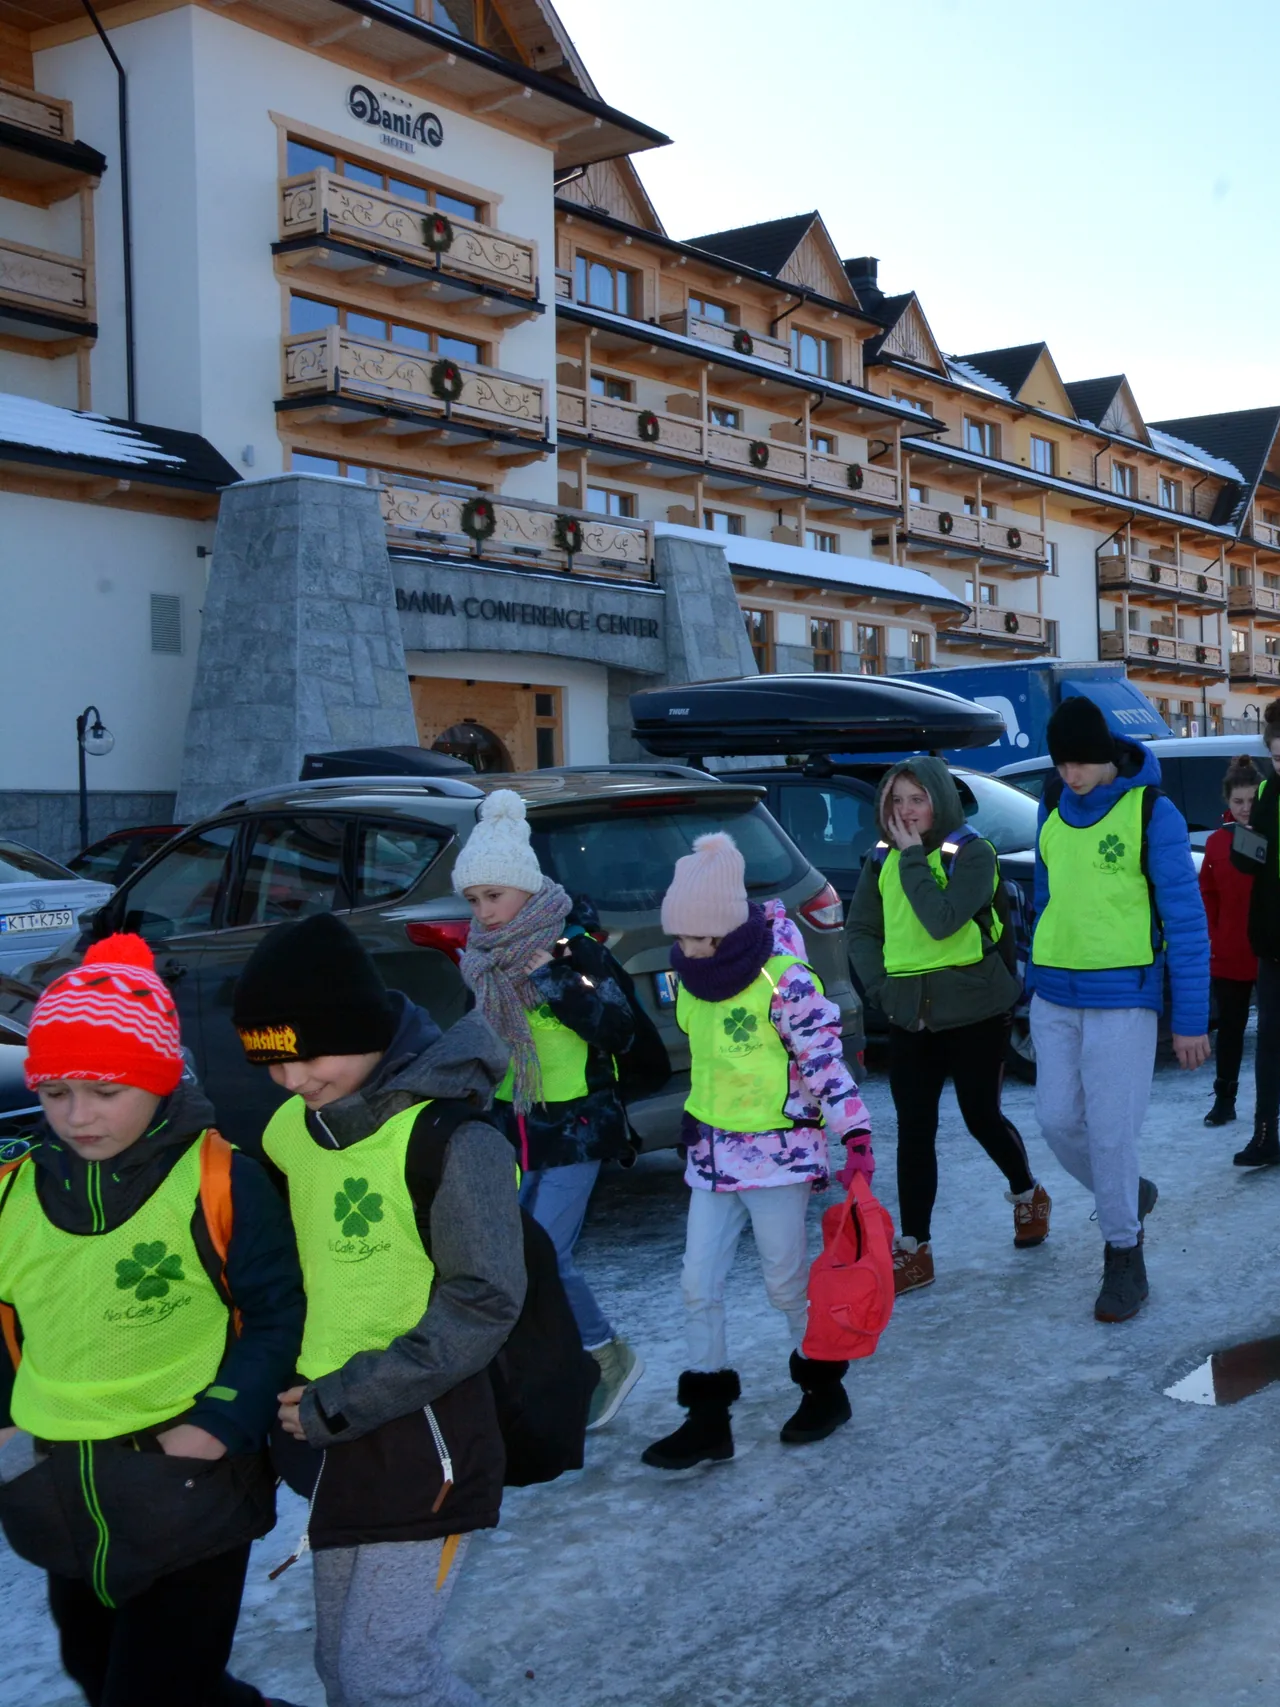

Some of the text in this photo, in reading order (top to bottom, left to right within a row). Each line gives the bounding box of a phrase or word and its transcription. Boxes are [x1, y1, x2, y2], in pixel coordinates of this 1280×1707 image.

[381, 134, 415, 154] HOTEL
[396, 587, 659, 639] BANIA CONFERENCE CENTER
[668, 708, 690, 716] THULE
[8, 912, 70, 930] KTT K759
